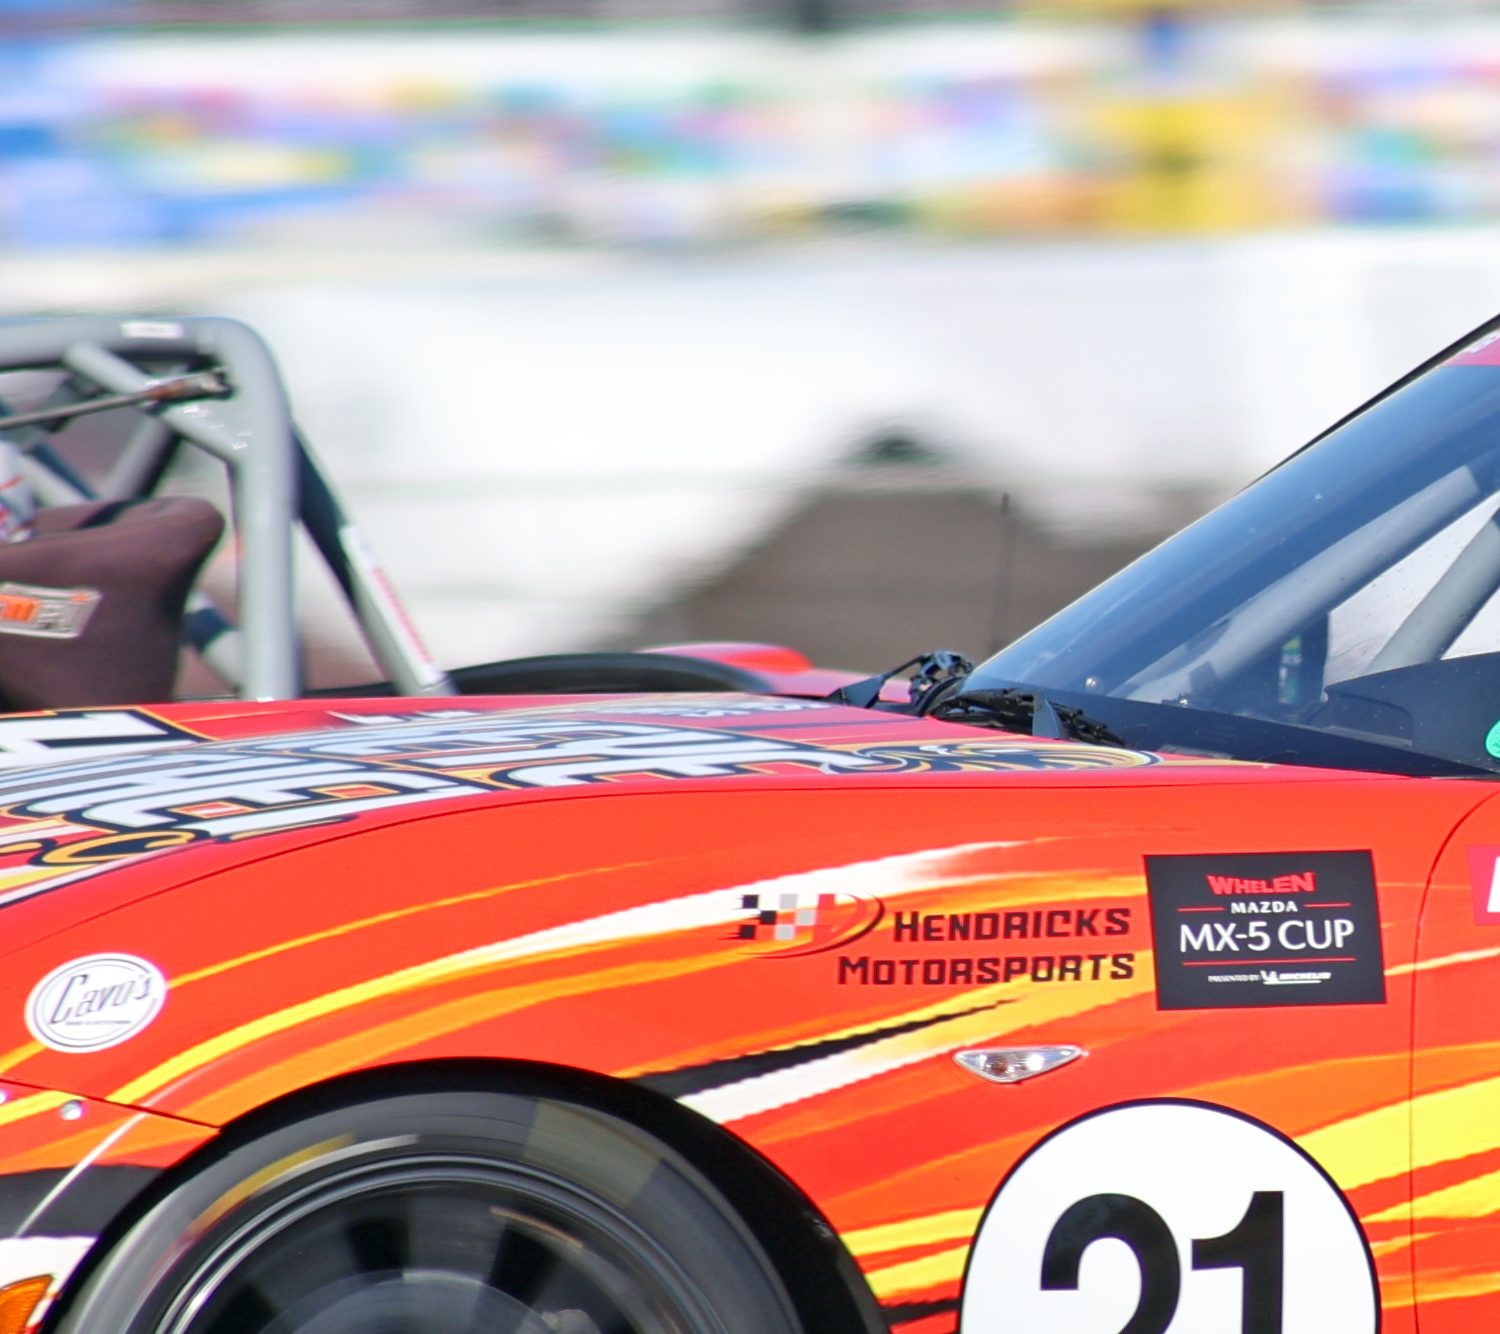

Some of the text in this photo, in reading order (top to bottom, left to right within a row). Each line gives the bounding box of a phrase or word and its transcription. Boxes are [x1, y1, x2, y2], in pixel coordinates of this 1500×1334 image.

[1206, 871, 1316, 895] WHELEN
[1231, 901, 1298, 914] MAZDA
[1180, 919, 1355, 952] MX-5 CUP
[49, 973, 154, 1025] Cavo's
